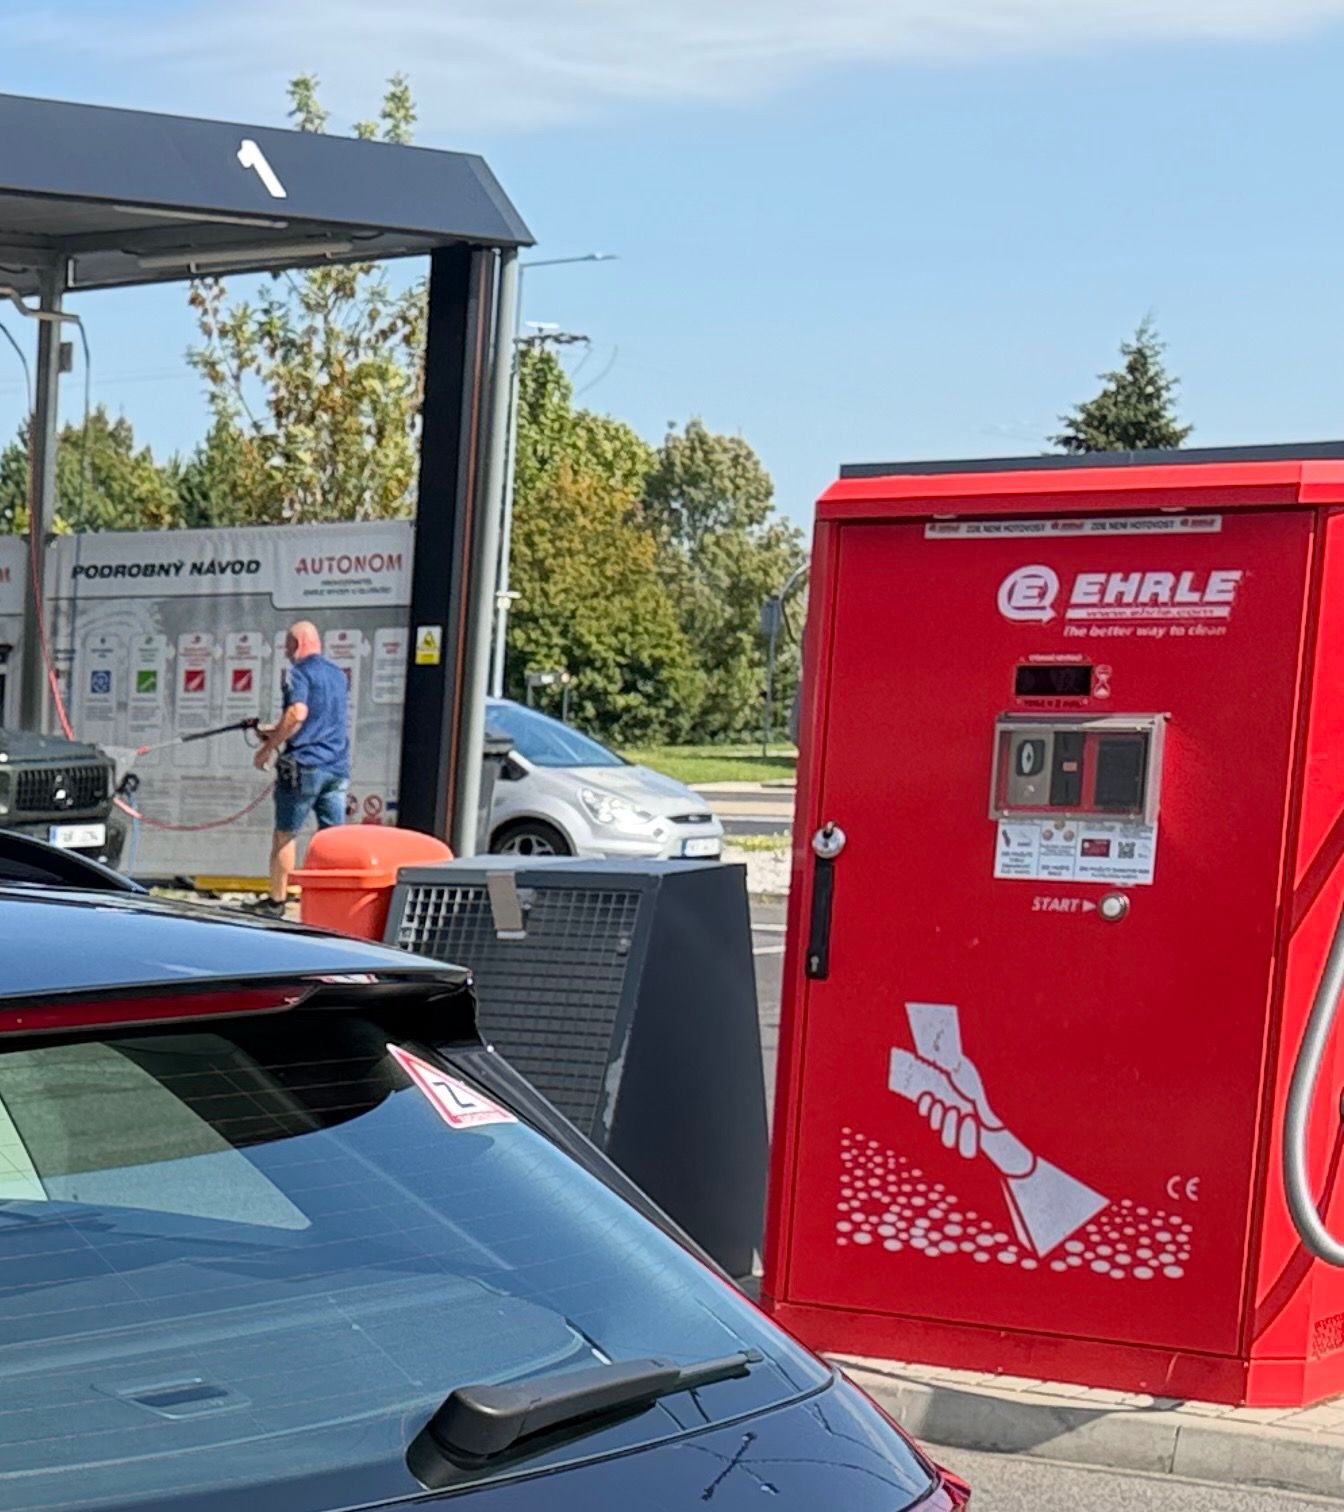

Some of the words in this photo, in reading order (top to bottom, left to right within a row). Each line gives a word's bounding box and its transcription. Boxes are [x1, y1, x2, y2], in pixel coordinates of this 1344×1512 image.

[237, 139, 287, 198] 1
[71, 560, 184, 580] PODROBNÝ
[190, 557, 261, 577] NÁVOD
[295, 553, 403, 576] AUTONOM
[1070, 570, 1243, 604] EHRLE
[1089, 625, 1135, 637] better
[1136, 626, 1167, 639] way
[1170, 625, 1185, 637] to
[1032, 896, 1080, 912] START
[1166, 1174, 1200, 1201] CE
